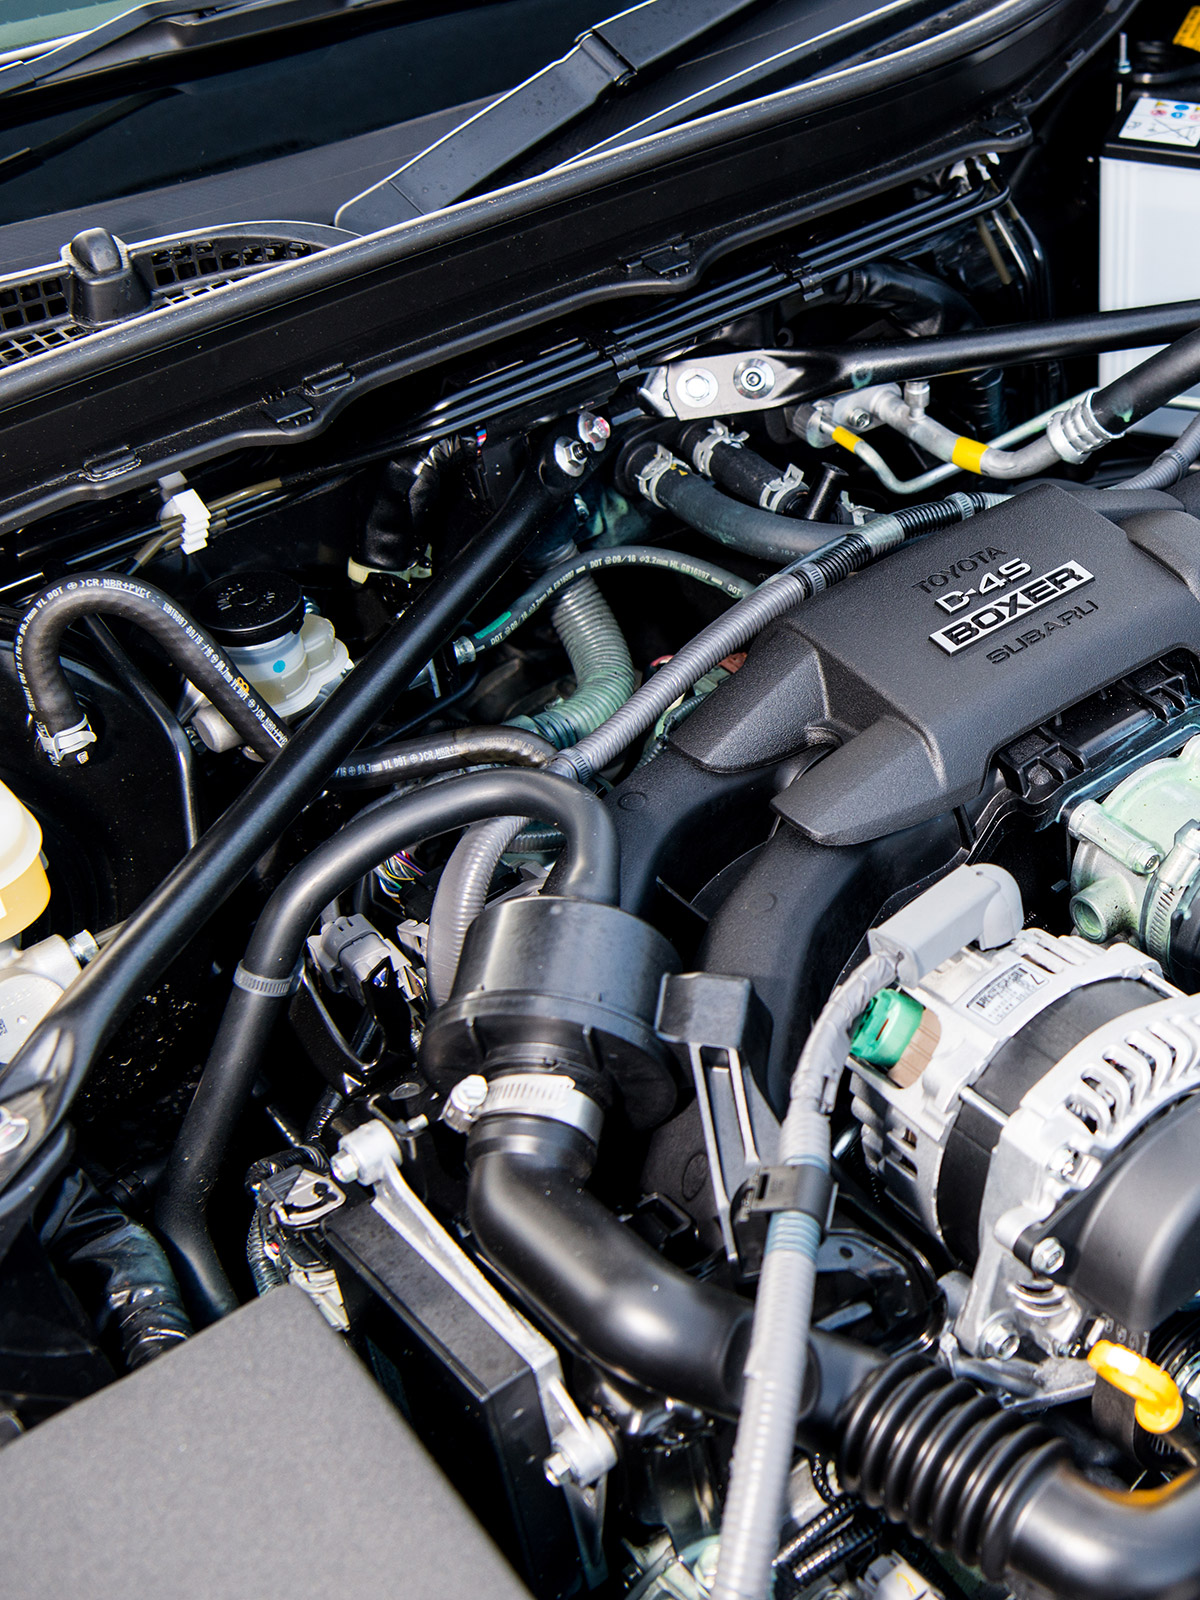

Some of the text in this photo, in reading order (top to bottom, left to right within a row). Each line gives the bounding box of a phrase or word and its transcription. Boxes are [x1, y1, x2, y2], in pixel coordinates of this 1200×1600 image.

[590, 558, 602, 568] DOT
[912, 546, 1007, 594] TOYOTA
[46, 586, 64, 600] DOT
[727, 584, 742, 596] DOT
[934, 557, 1032, 615] D-4S
[941, 567, 1084, 646] BOXER
[490, 632, 503, 645] DOT
[986, 600, 1099, 664] SUBARU
[392, 755, 407, 767] DOT
